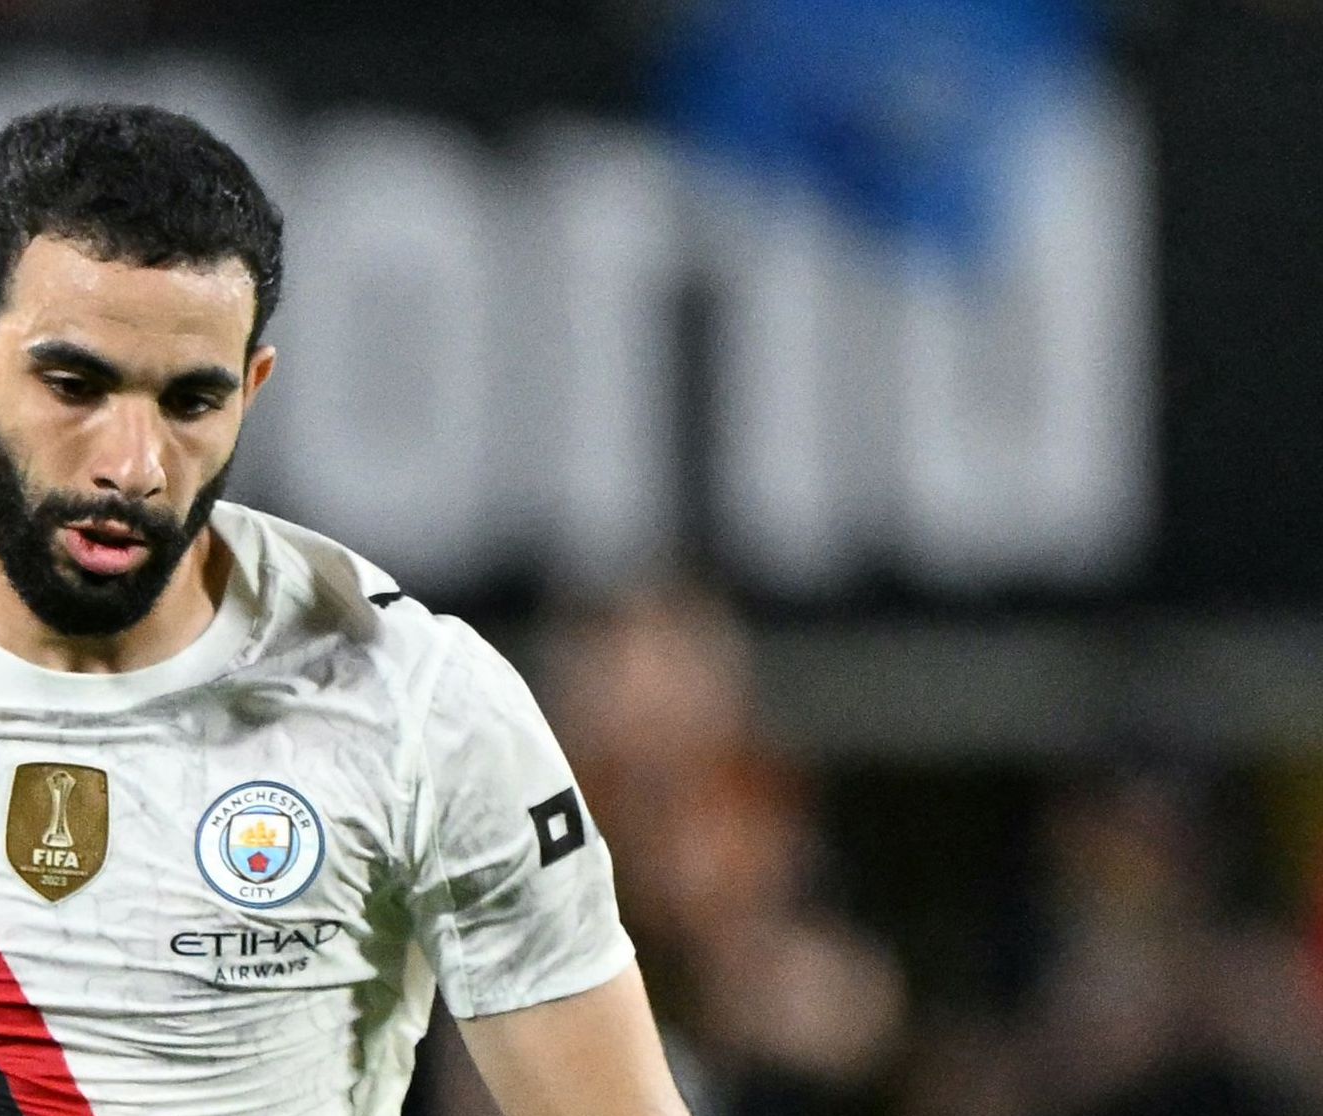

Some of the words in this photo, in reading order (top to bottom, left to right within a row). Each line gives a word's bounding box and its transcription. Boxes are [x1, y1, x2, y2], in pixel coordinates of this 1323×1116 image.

[212, 791, 311, 829] MANCHESTER
[32, 848, 79, 868] FIFA
[239, 886, 275, 898] CITY
[170, 920, 343, 957] ETIHAD
[214, 957, 309, 983] AIRWAYS
